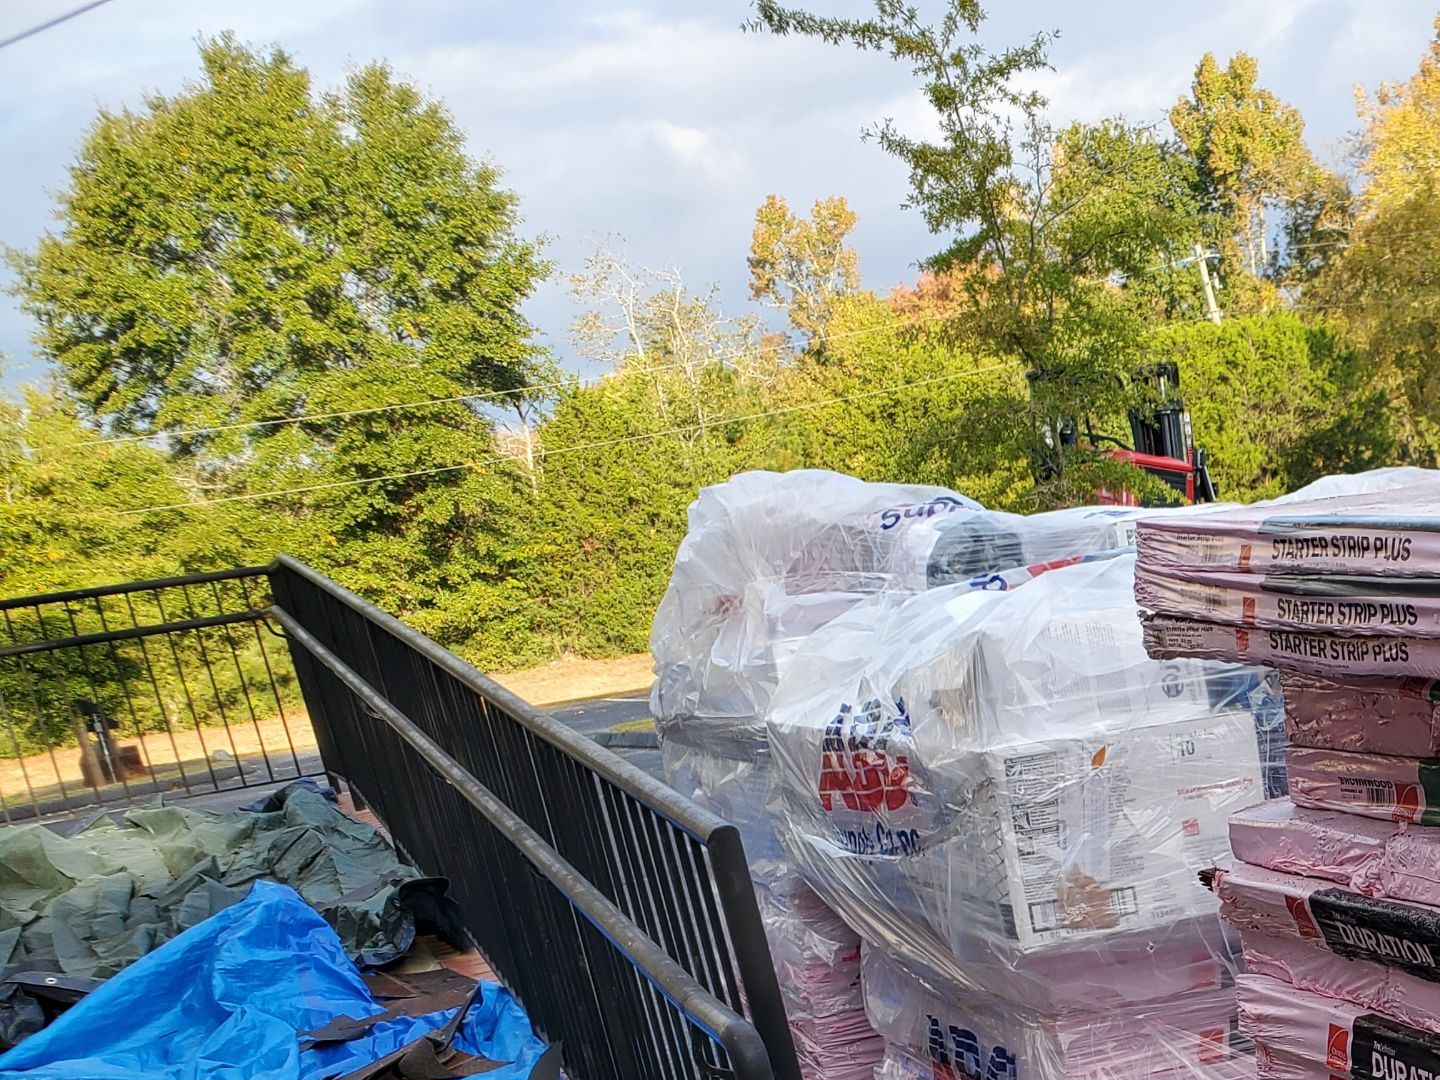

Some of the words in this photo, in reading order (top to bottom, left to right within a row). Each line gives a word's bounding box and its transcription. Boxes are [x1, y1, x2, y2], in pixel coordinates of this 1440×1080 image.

[1271, 536, 1329, 560] STARTER
[1331, 535, 1370, 558] STRIP
[1373, 536, 1413, 562] PLUS
[1277, 599, 1334, 624] STARTER
[1337, 601, 1378, 625] STRIP
[1381, 603, 1419, 626] PLUS
[1269, 632, 1328, 659] STARTER
[1329, 636, 1369, 661] STRIP
[1372, 640, 1410, 663] PLUS
[1337, 922, 1435, 968] DURATION
